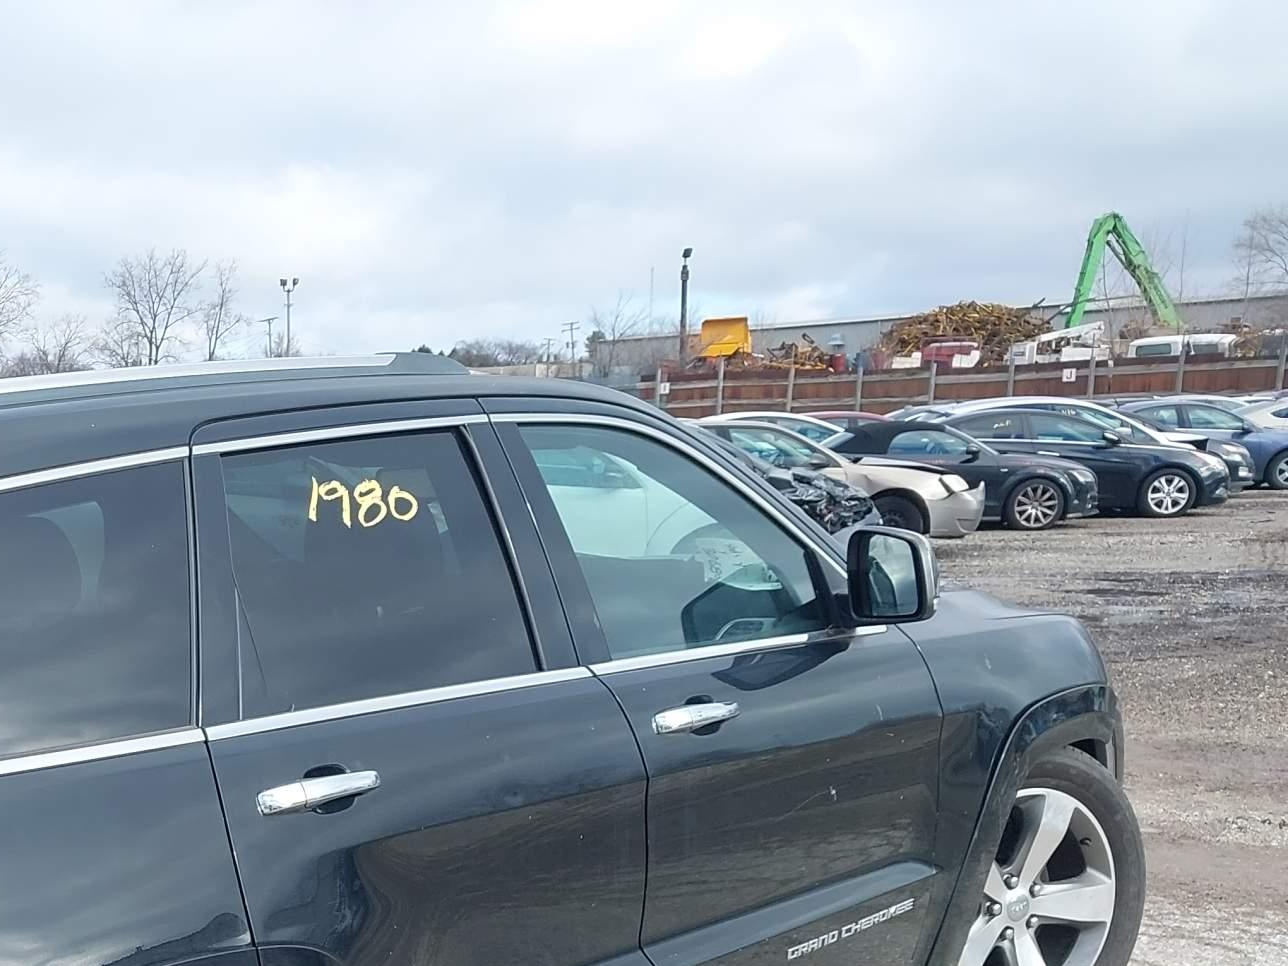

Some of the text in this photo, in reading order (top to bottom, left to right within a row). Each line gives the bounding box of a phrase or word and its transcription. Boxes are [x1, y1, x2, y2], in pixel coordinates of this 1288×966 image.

[308, 475, 419, 529] 1980
[787, 897, 916, 961] GRAND CHEROKEE
